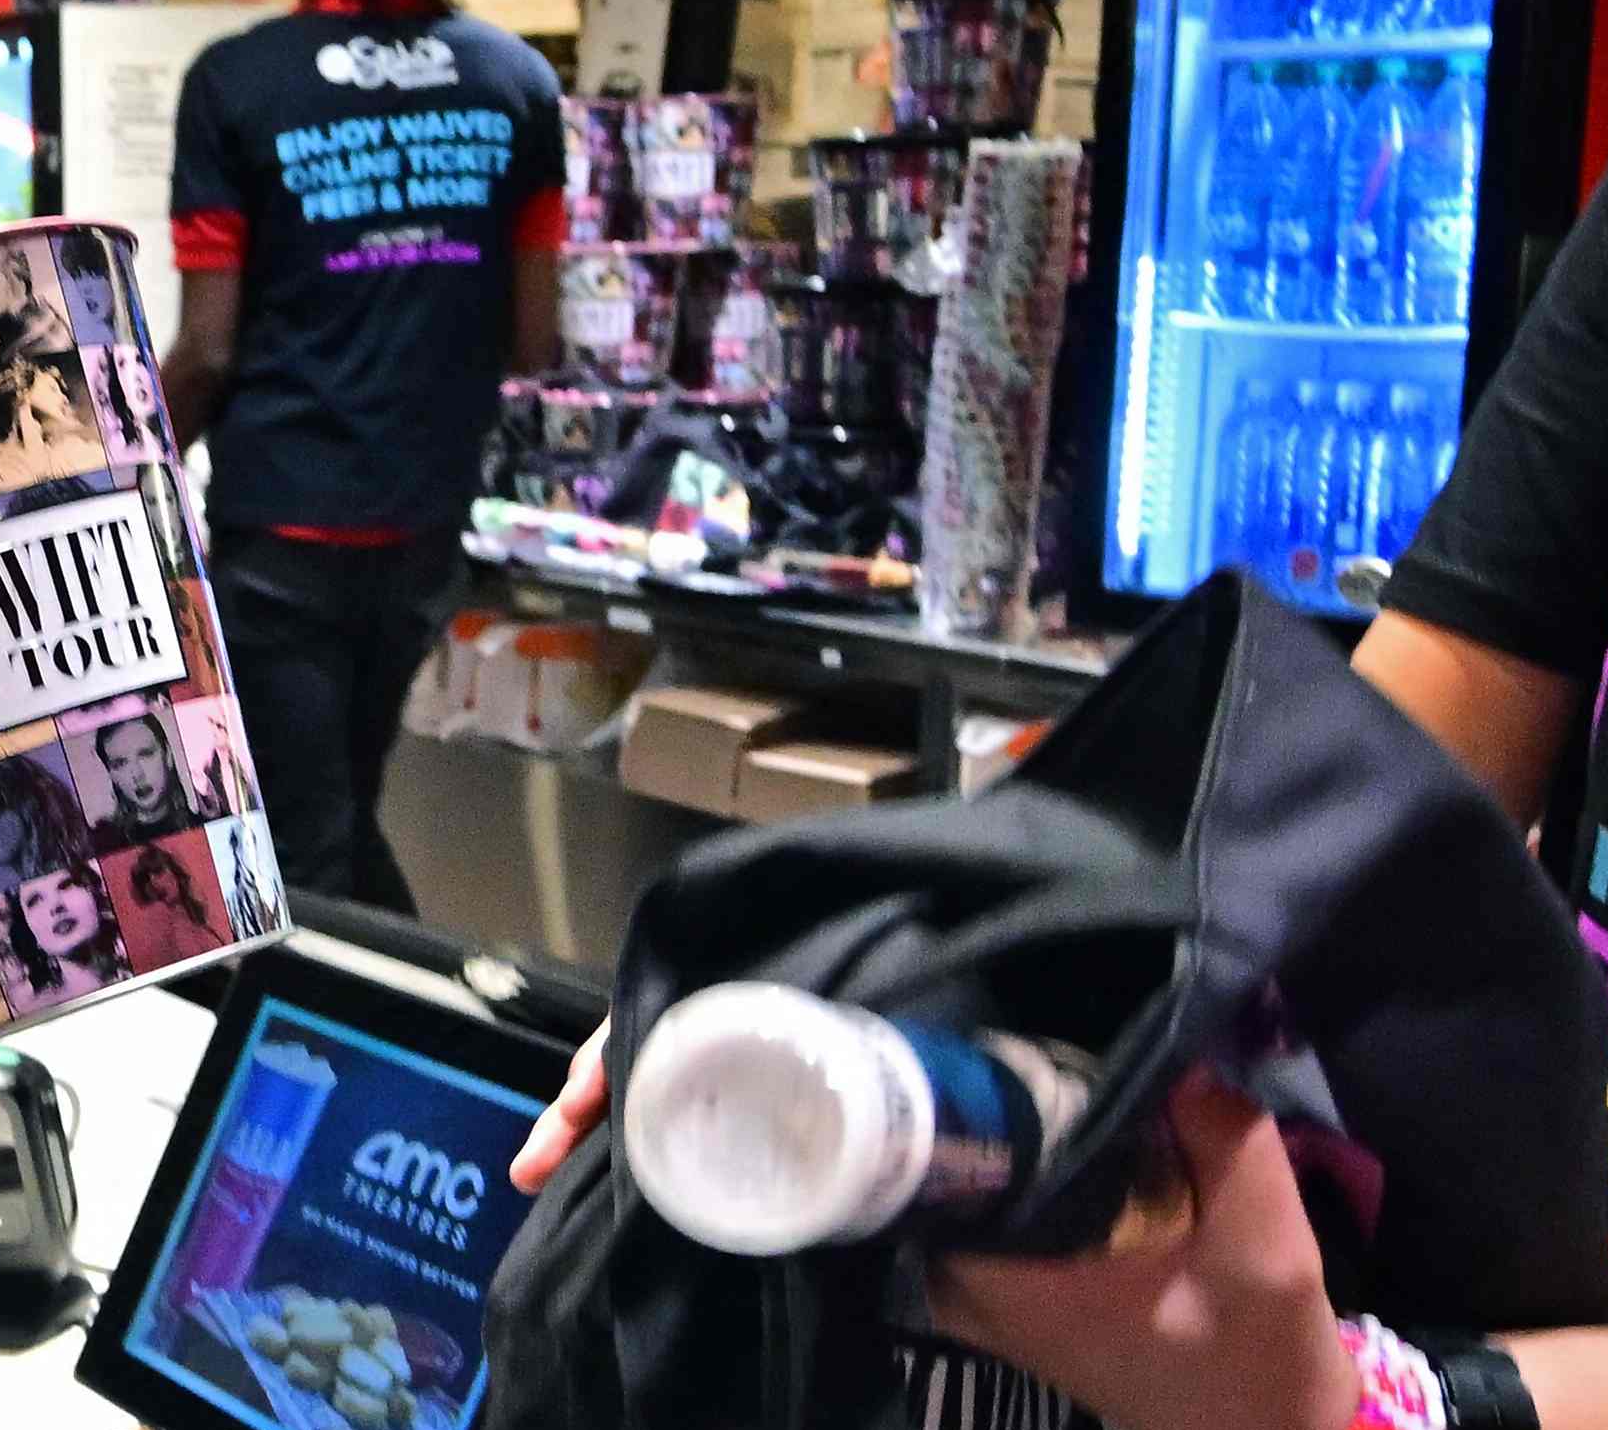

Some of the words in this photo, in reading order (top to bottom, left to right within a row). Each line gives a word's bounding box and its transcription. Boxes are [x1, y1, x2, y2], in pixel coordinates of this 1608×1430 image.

[274, 115, 384, 164] ENJOY
[6, 613, 164, 691] TOUR
[343, 1171, 469, 1253] THEATRES
[351, 1128, 485, 1222] amc
